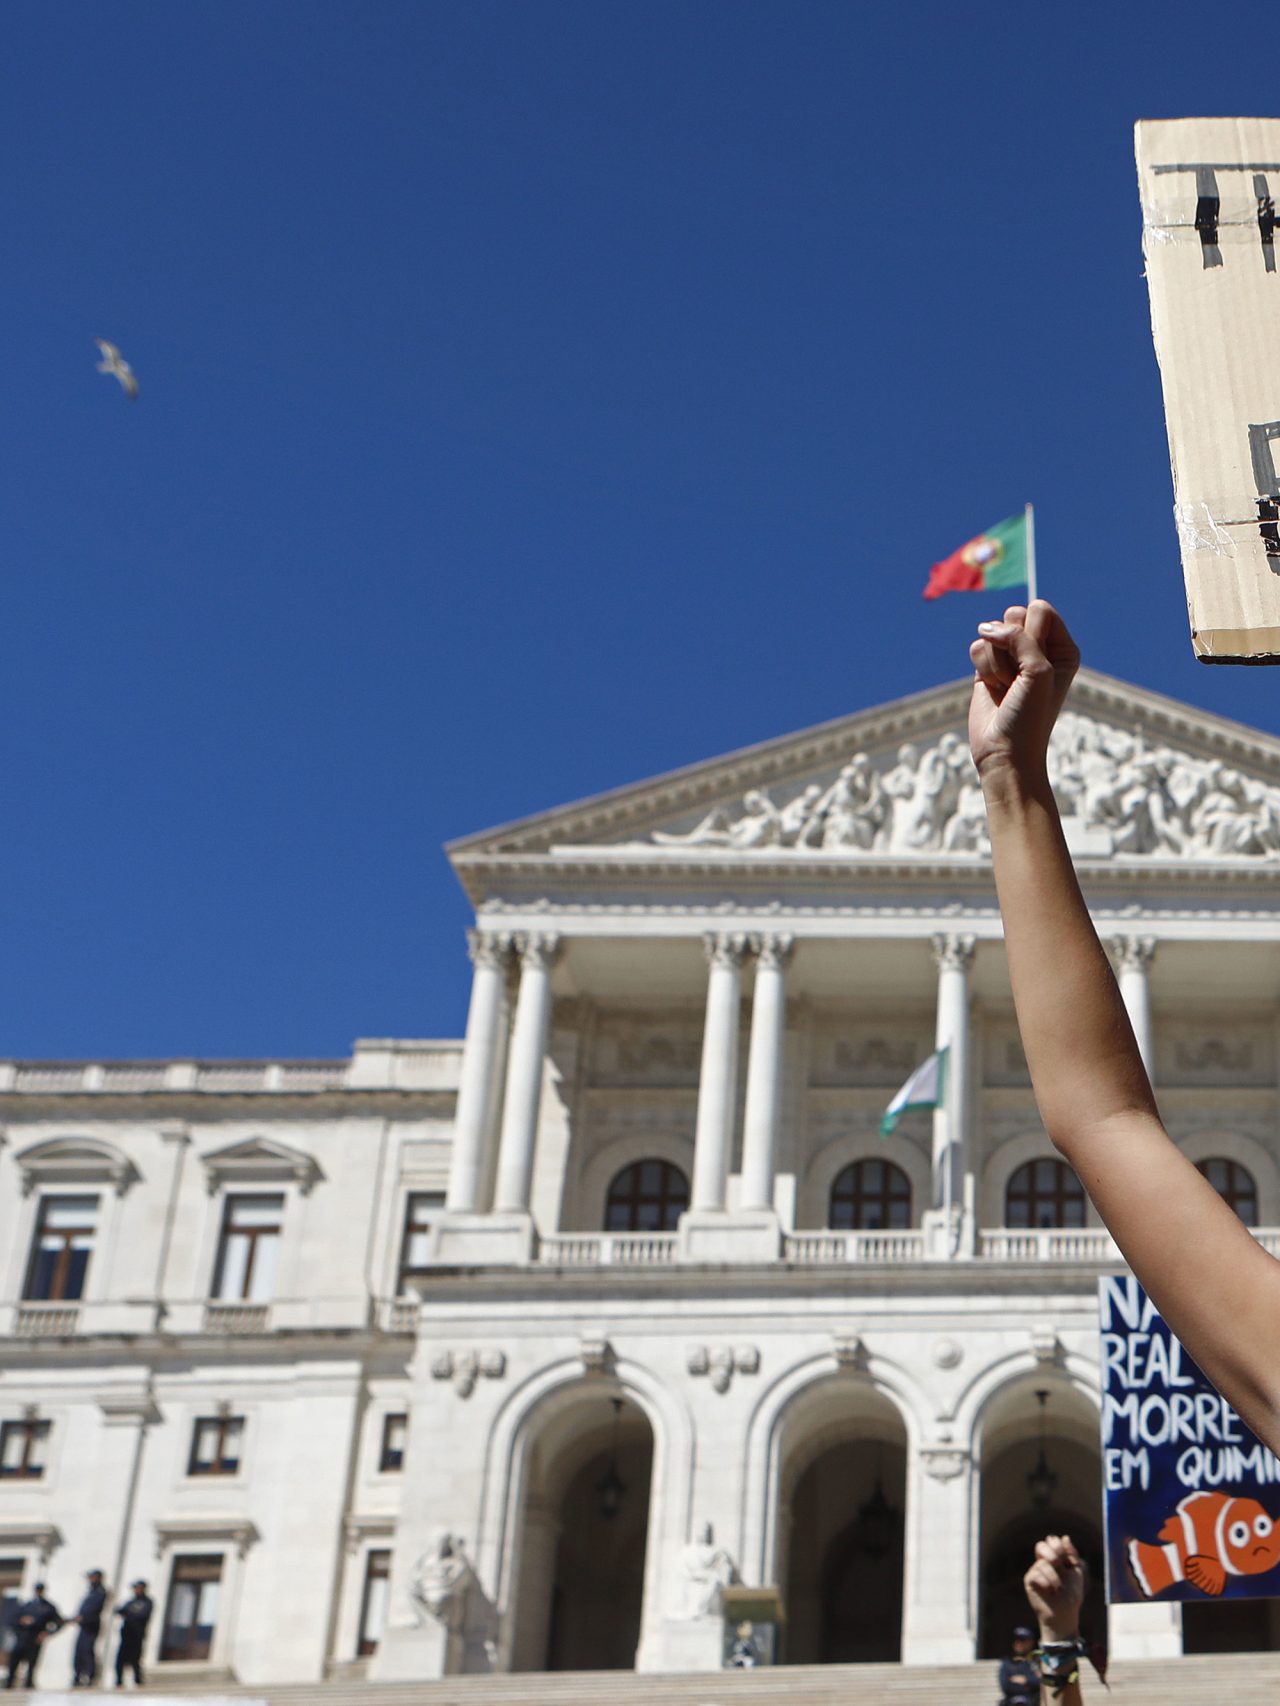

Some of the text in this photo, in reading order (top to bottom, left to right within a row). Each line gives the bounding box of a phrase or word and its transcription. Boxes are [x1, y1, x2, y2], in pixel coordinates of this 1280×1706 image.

[1100, 1332, 1195, 1390] REAL
[1102, 1393, 1244, 1446] MORRE
[1106, 1447, 1150, 1491] EM
